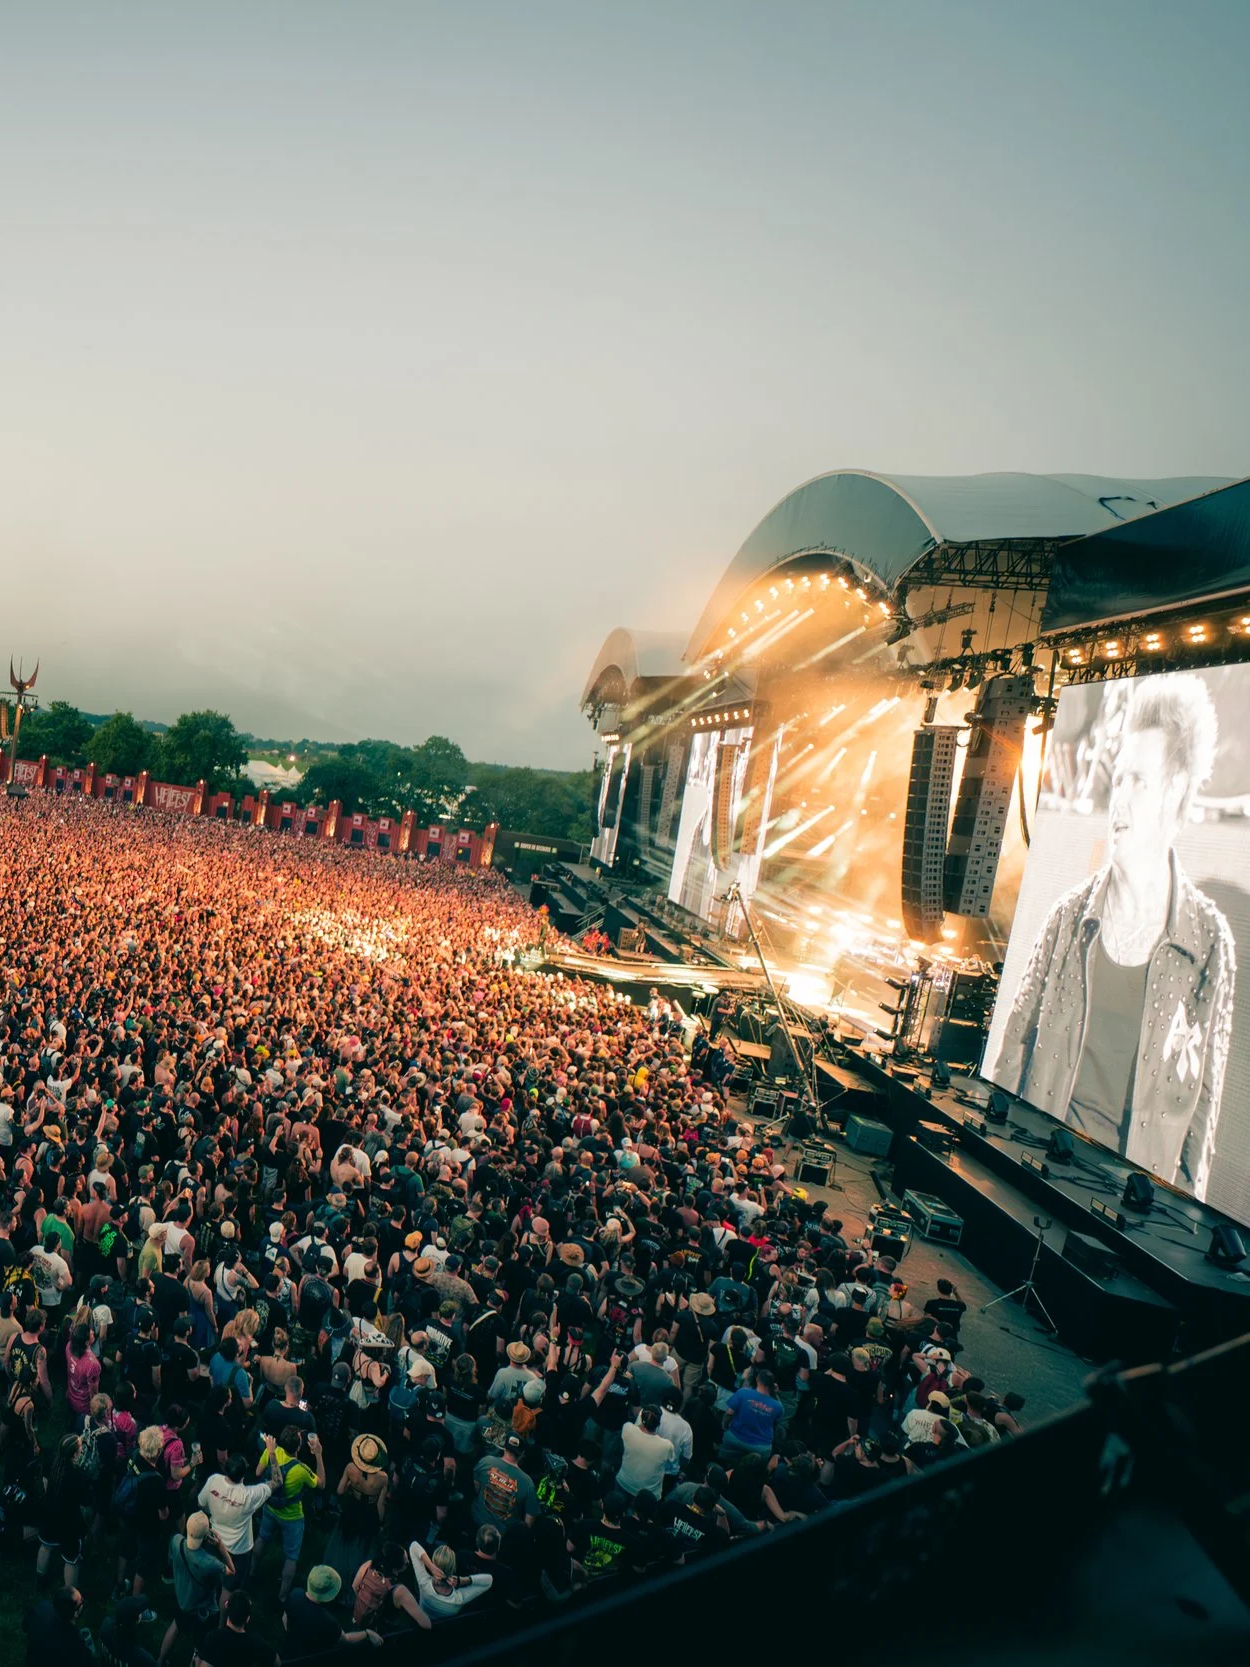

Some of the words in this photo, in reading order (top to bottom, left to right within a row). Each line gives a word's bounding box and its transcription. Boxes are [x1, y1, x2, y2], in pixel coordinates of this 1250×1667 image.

[155, 786, 195, 812] HELLFEST
[673, 1517, 705, 1541] HELLFEST
[590, 1535, 625, 1554] HELLFEST
